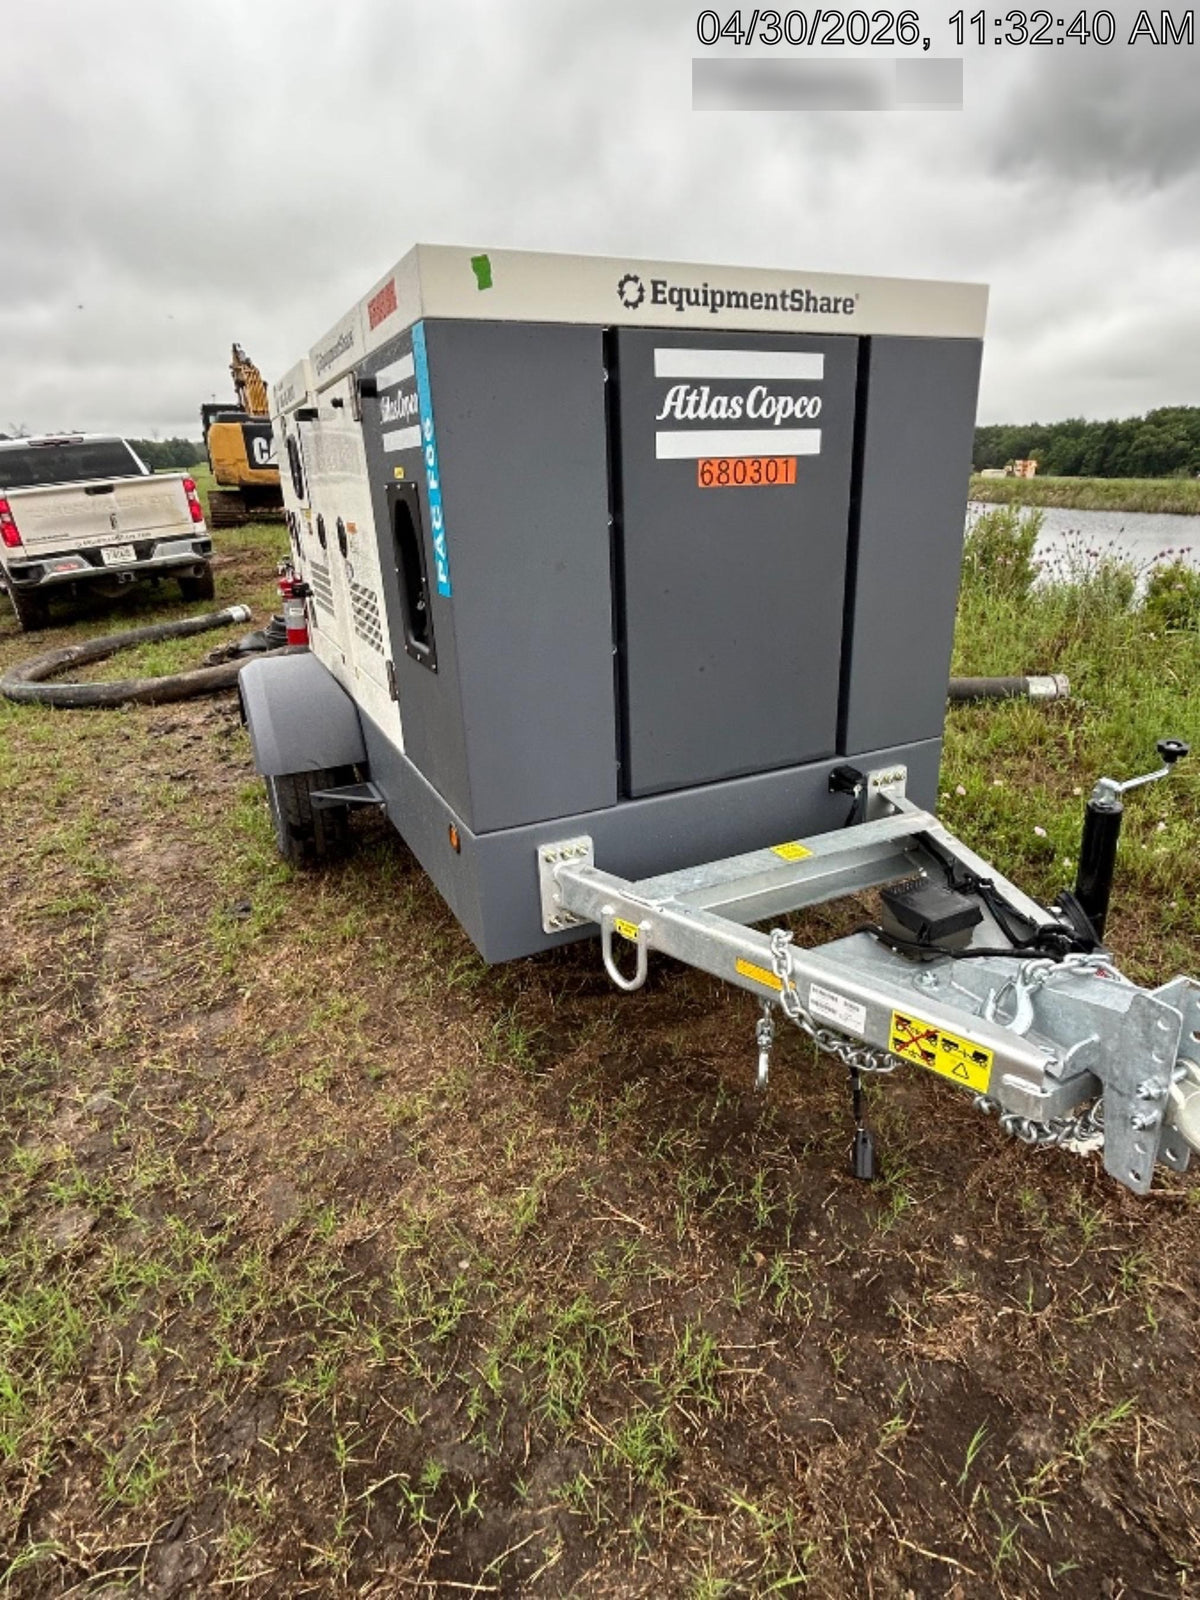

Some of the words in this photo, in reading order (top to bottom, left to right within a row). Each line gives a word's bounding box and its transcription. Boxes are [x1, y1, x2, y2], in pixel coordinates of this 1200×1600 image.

[651, 279, 856, 315] EquipmentShare
[656, 384, 744, 420] Atlas
[746, 385, 823, 426] Copco
[700, 459, 791, 486] 680301
